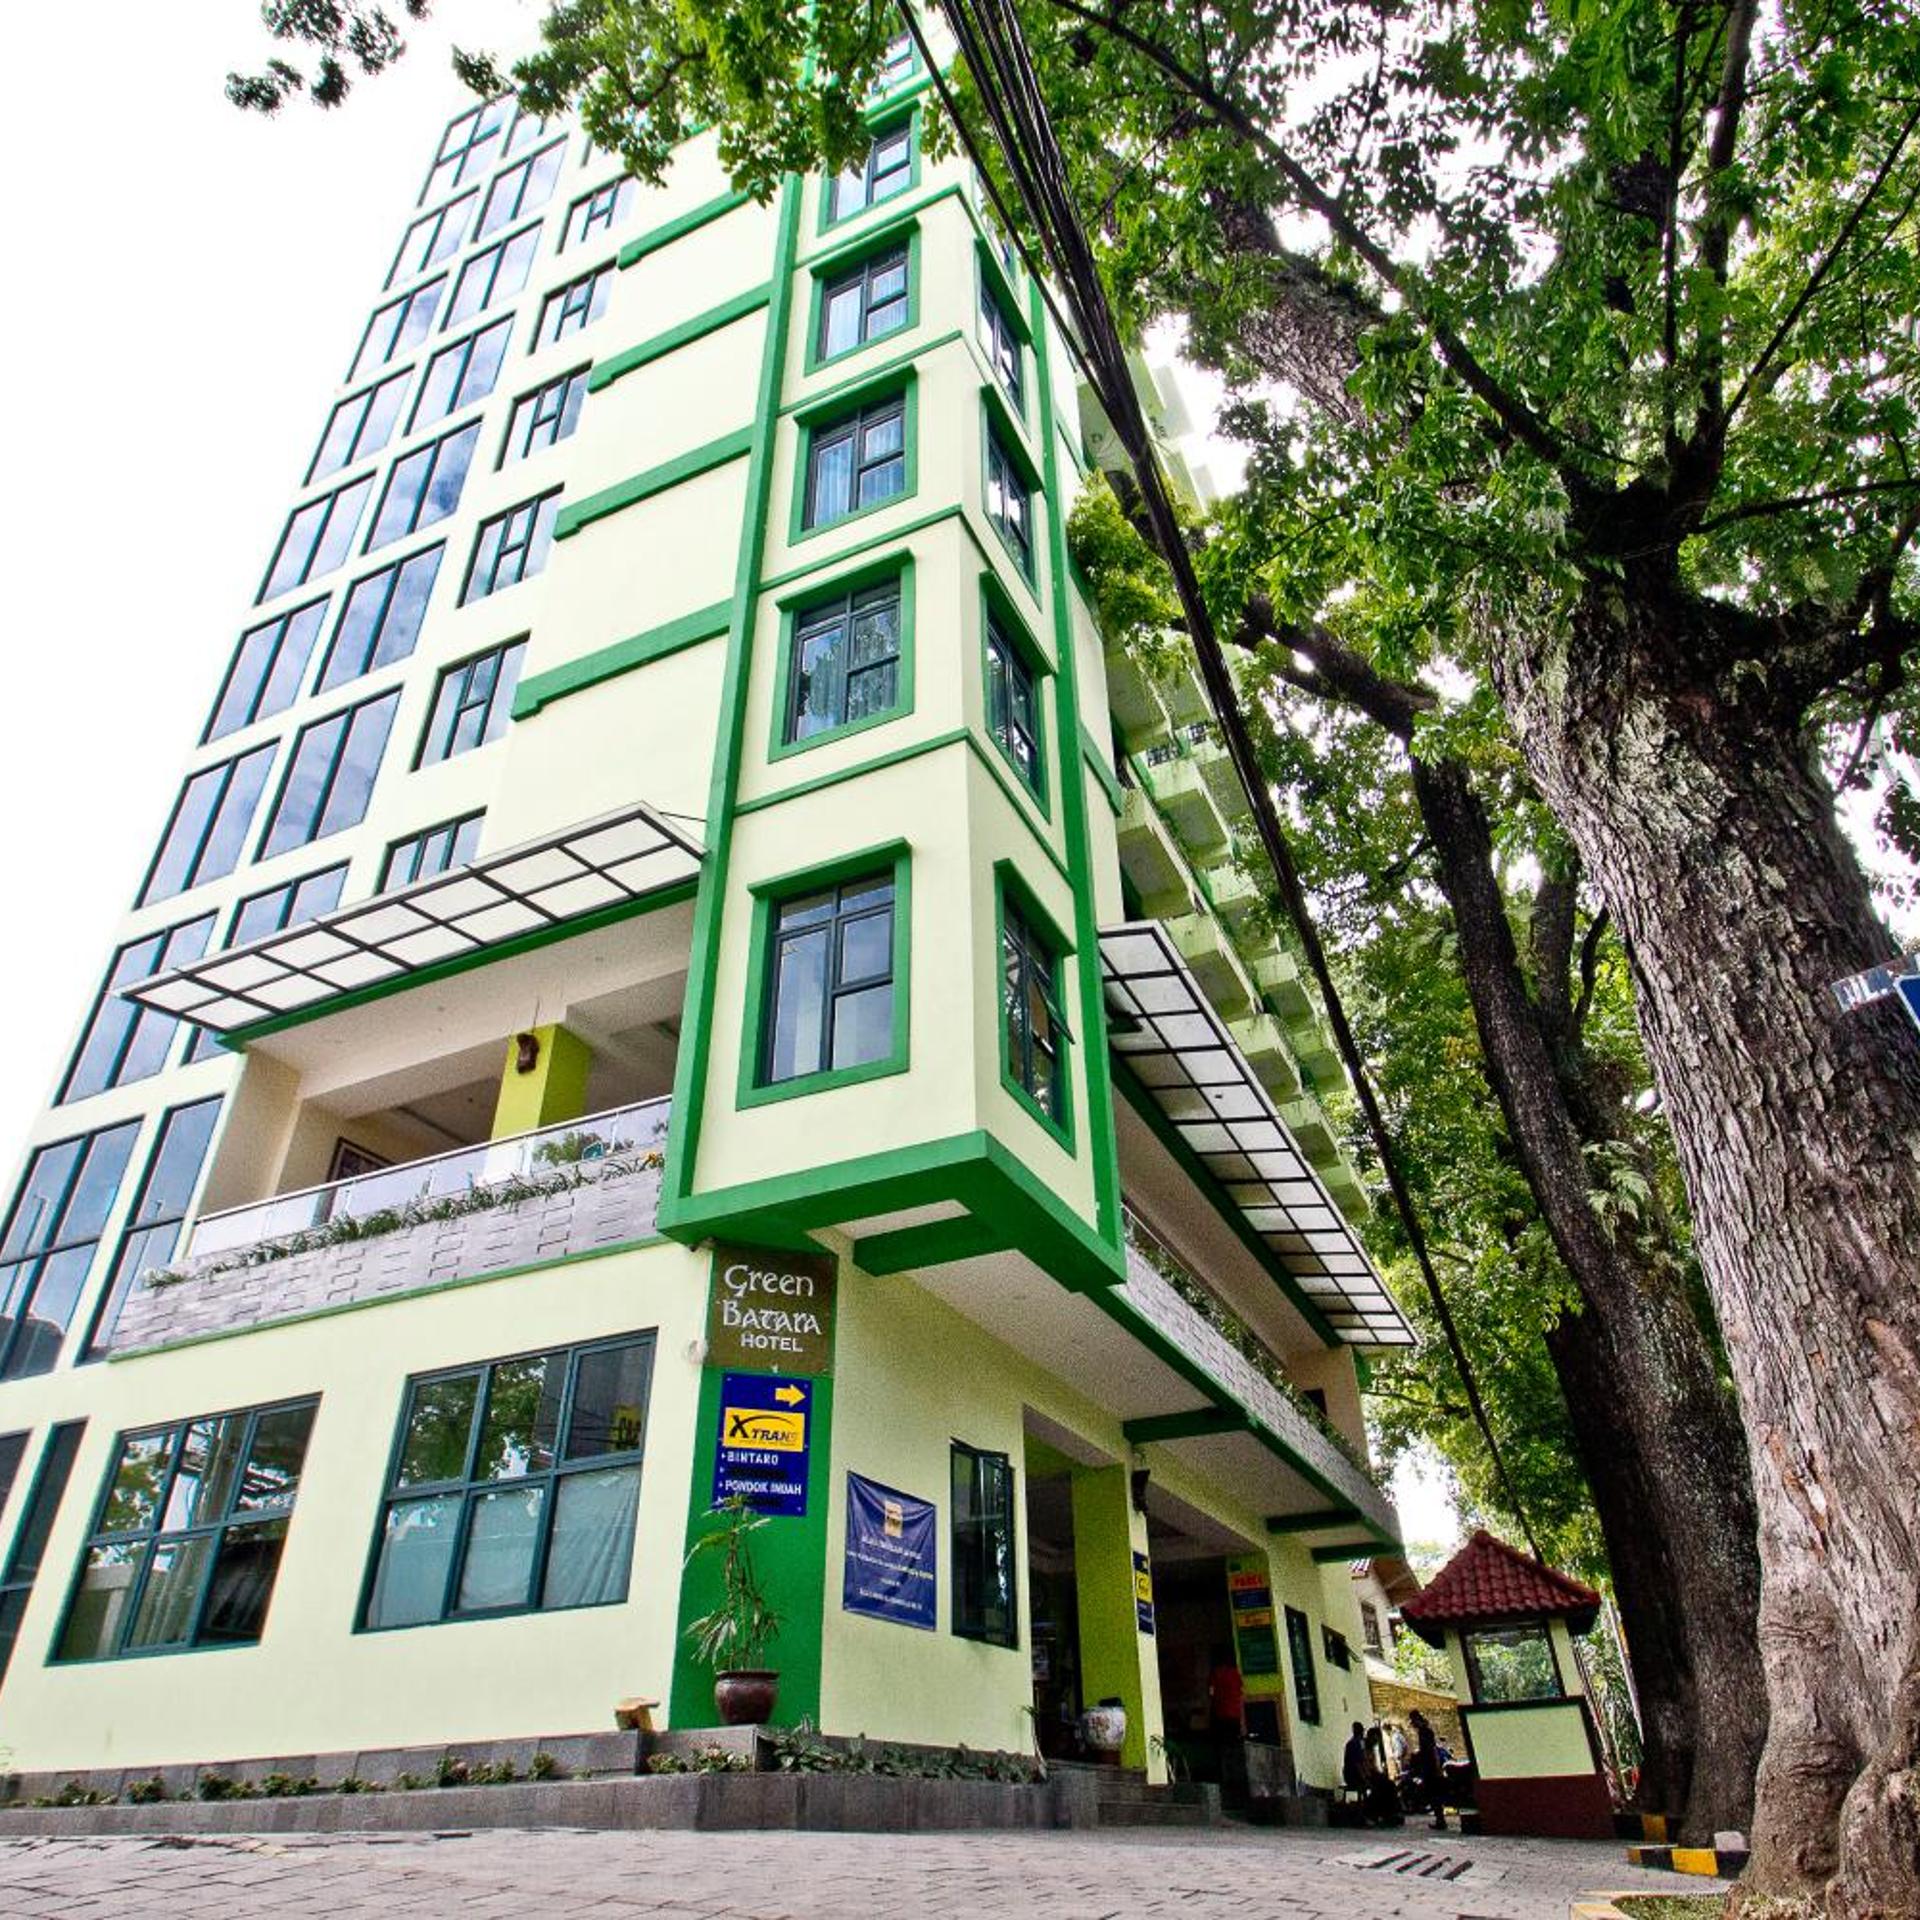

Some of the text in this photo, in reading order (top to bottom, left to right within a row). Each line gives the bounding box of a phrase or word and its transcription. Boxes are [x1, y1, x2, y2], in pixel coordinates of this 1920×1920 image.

[724, 1264, 814, 1297] Green
[740, 1332, 804, 1353] HOTEL
[727, 1451, 779, 1466] BINTARO
[724, 1479, 802, 1496] PONDOK INDAH
